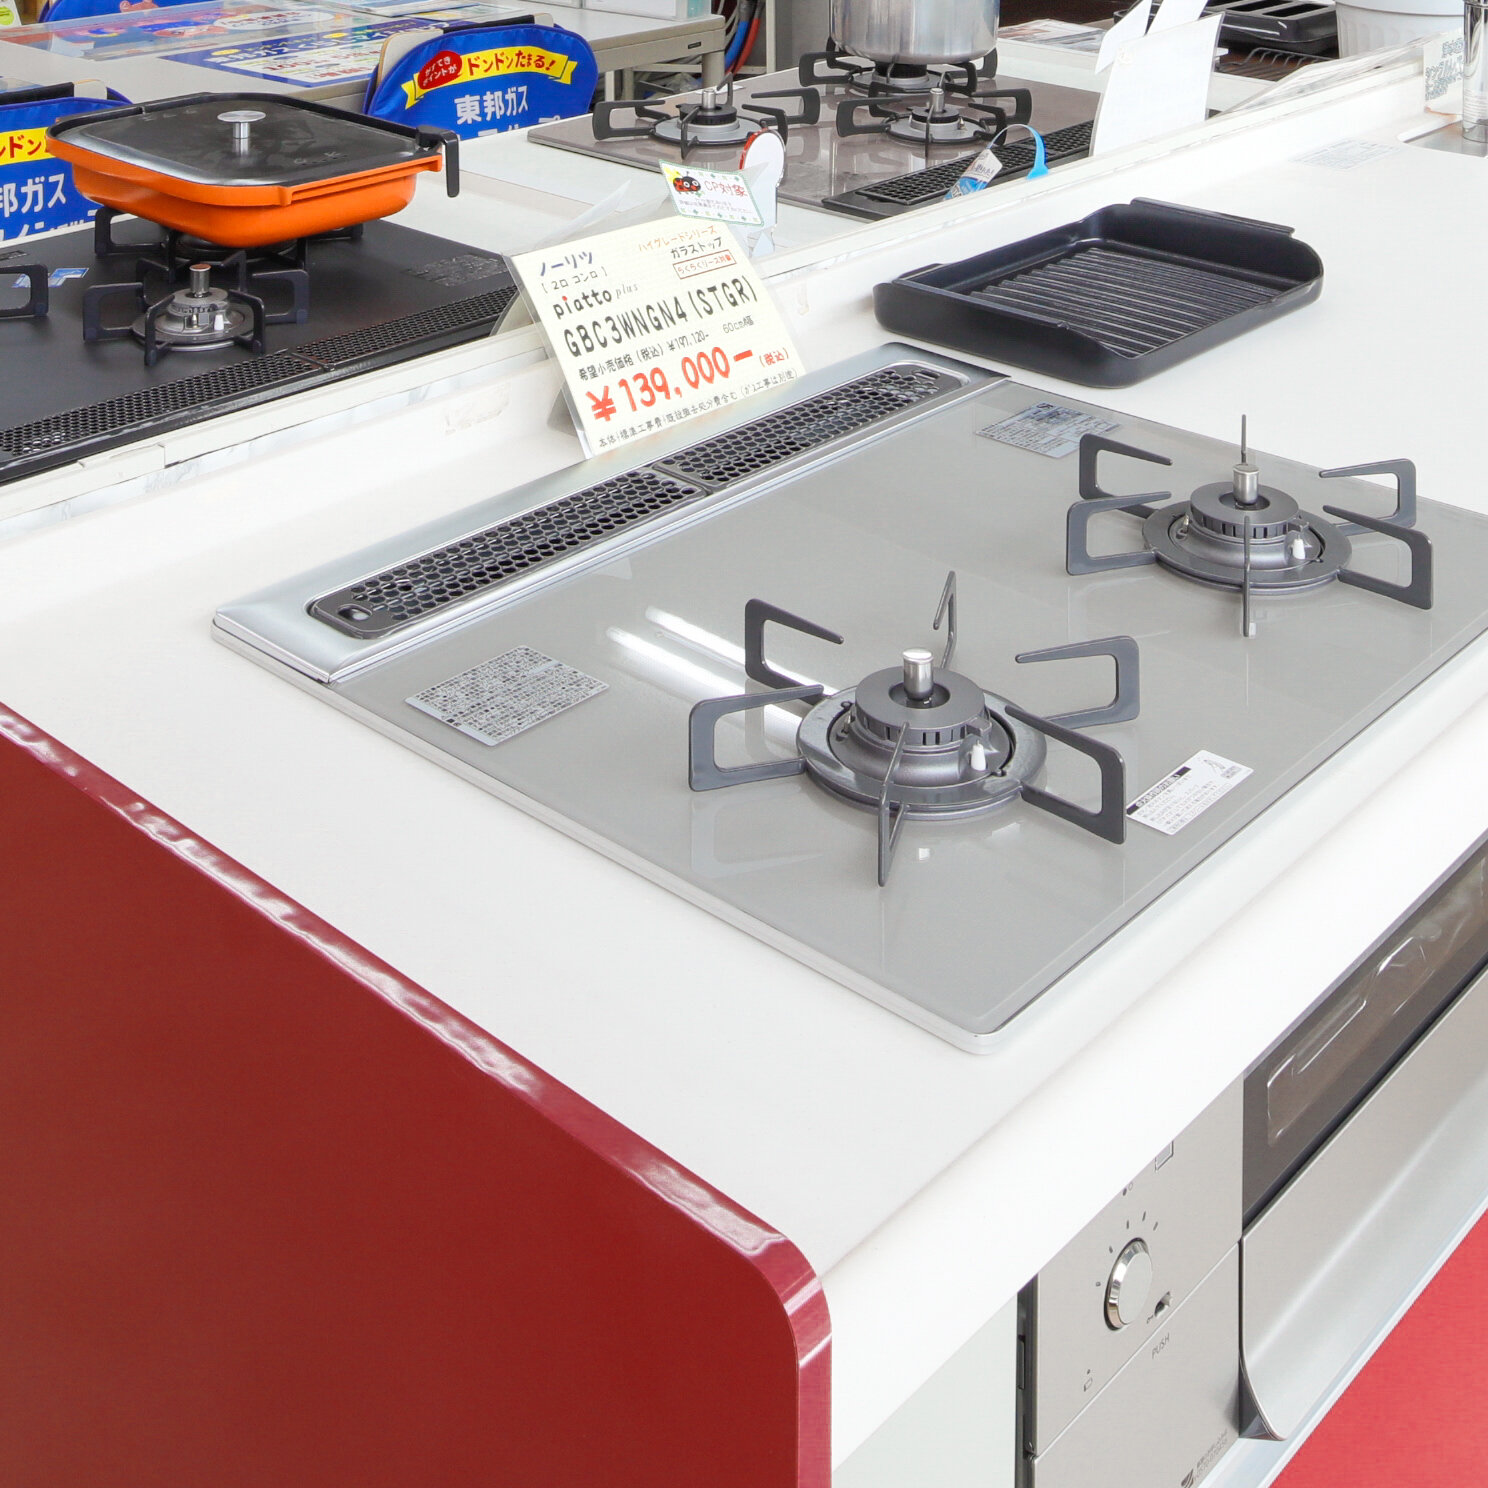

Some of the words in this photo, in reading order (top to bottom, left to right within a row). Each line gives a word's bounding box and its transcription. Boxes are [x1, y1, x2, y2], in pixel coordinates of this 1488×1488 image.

[468, 50, 556, 76] ドンドンたまる!
[455, 86, 528, 124] 東邦ガス
[705, 179, 747, 197] CP対象
[638, 225, 716, 252] ハイグレードシリーズ
[670, 237, 721, 258] ガラストップ
[540, 252, 593, 276] ノーリツ
[677, 255, 731, 273] らくらくリース対象
[553, 288, 612, 319] piatto
[615, 282, 638, 298] plus
[578, 354, 634, 381] 希望小売価格
[586, 347, 753, 421] ¥139,000-
[759, 347, 789, 367] (税込)
[1152, 1333, 1171, 1359] PUSH
